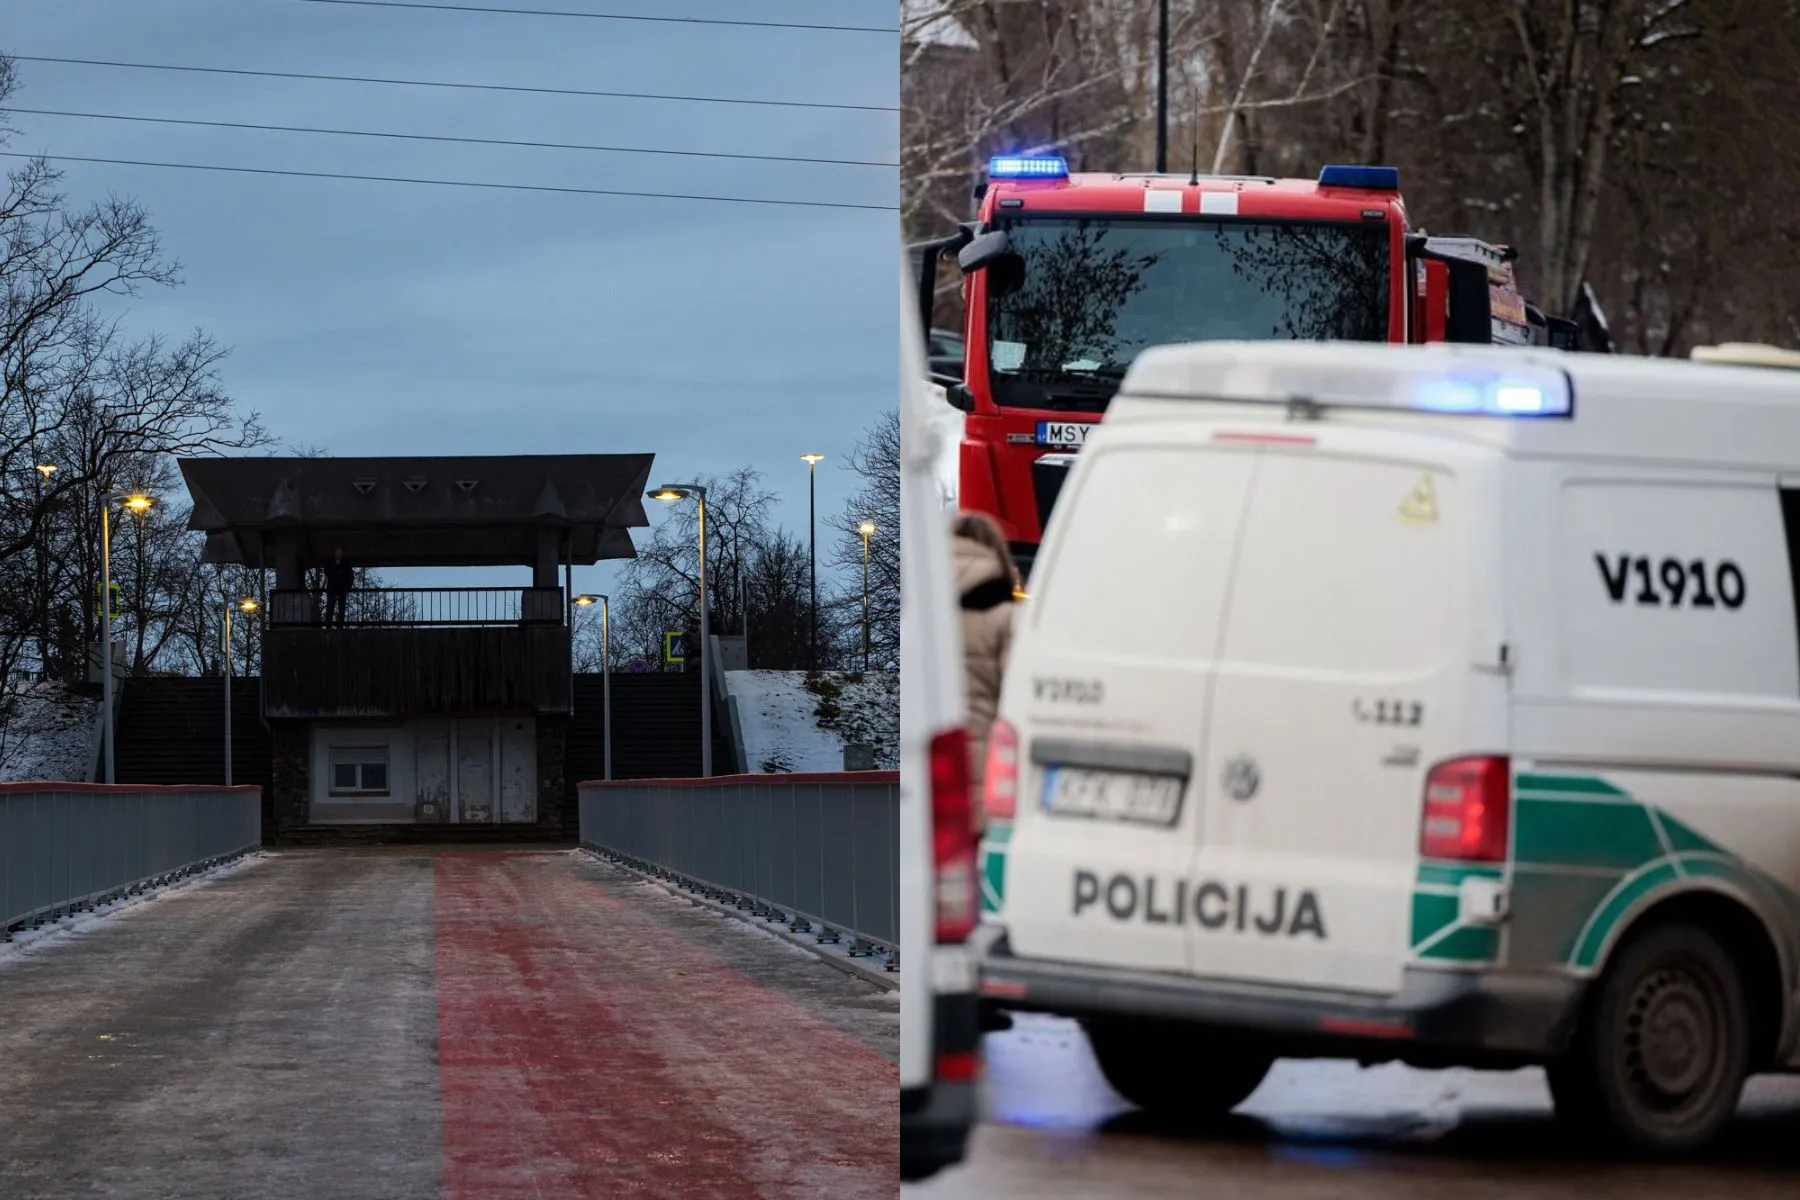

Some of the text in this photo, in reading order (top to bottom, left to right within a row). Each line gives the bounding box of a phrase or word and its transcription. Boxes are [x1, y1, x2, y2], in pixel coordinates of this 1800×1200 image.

[1049, 424, 1090, 442] MSY
[1594, 551, 1746, 610] V1910
[1073, 869, 1327, 939] POLICIJA
